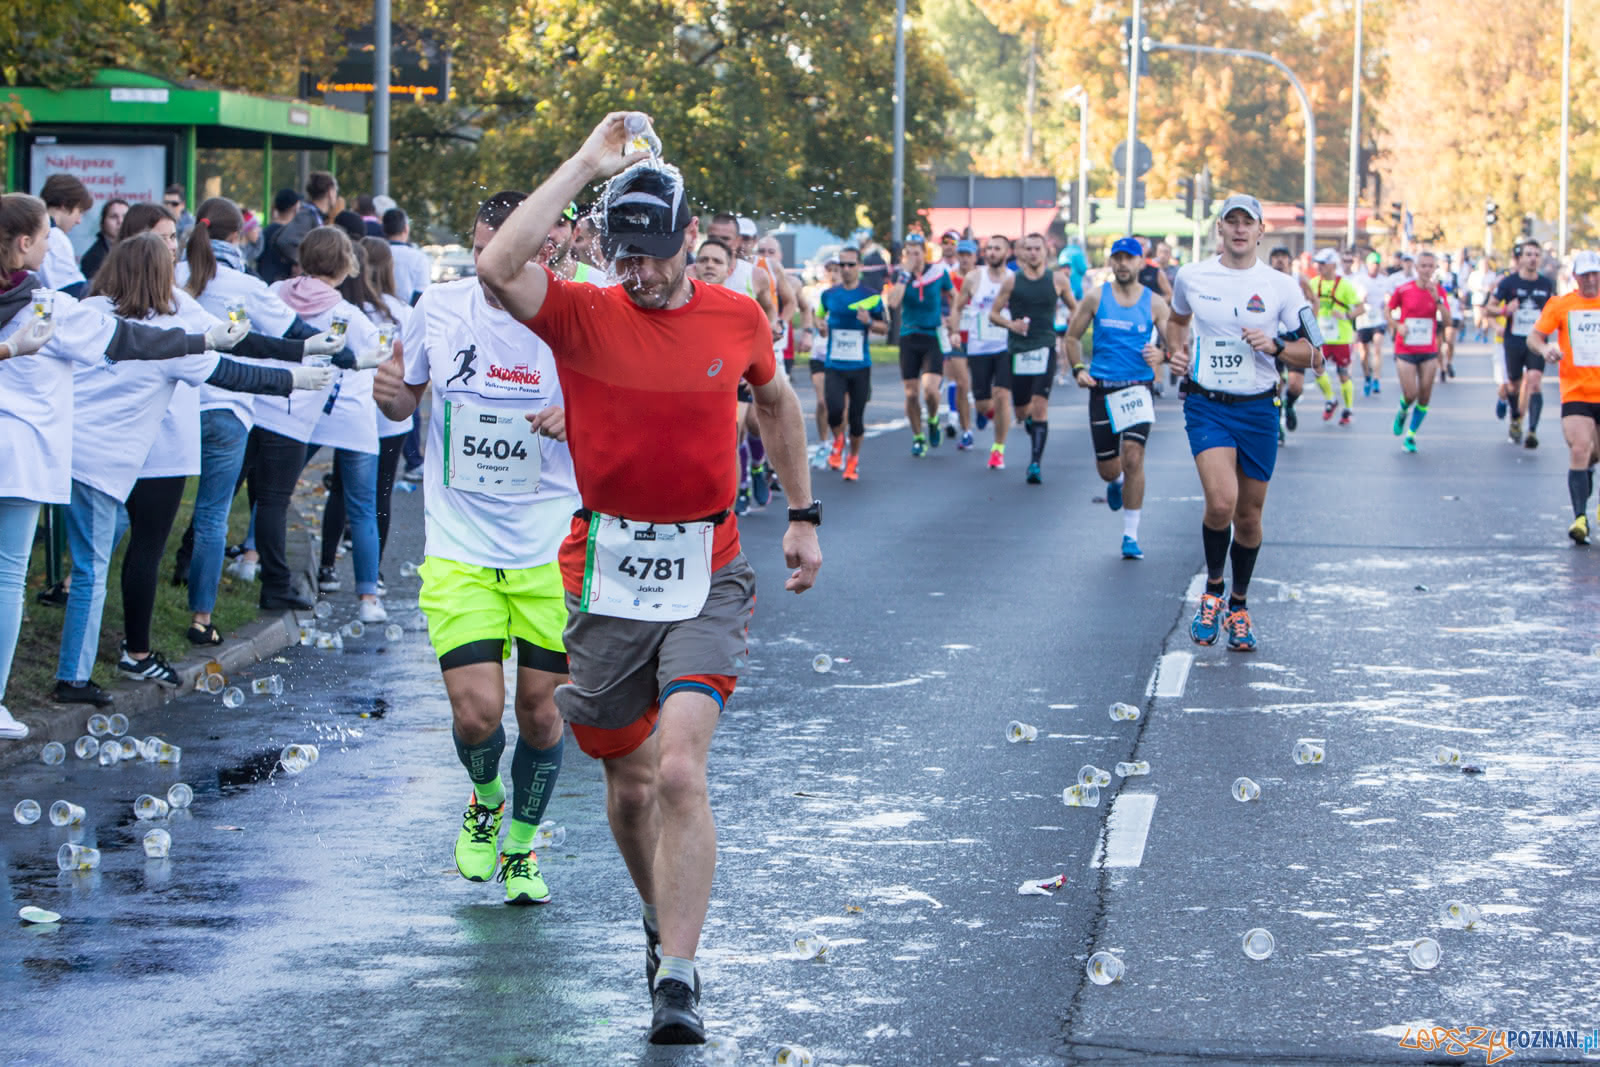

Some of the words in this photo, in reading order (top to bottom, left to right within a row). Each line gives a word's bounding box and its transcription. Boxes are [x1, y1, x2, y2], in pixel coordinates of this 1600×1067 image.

[1210, 354, 1243, 368] 3139
[485, 381, 518, 392] Volkswagen
[1120, 398, 1144, 414] 1198
[462, 434, 528, 460] 5404
[476, 462, 509, 472] Grzegorz
[618, 556, 685, 580] 4781
[637, 585, 664, 593] Jakub
